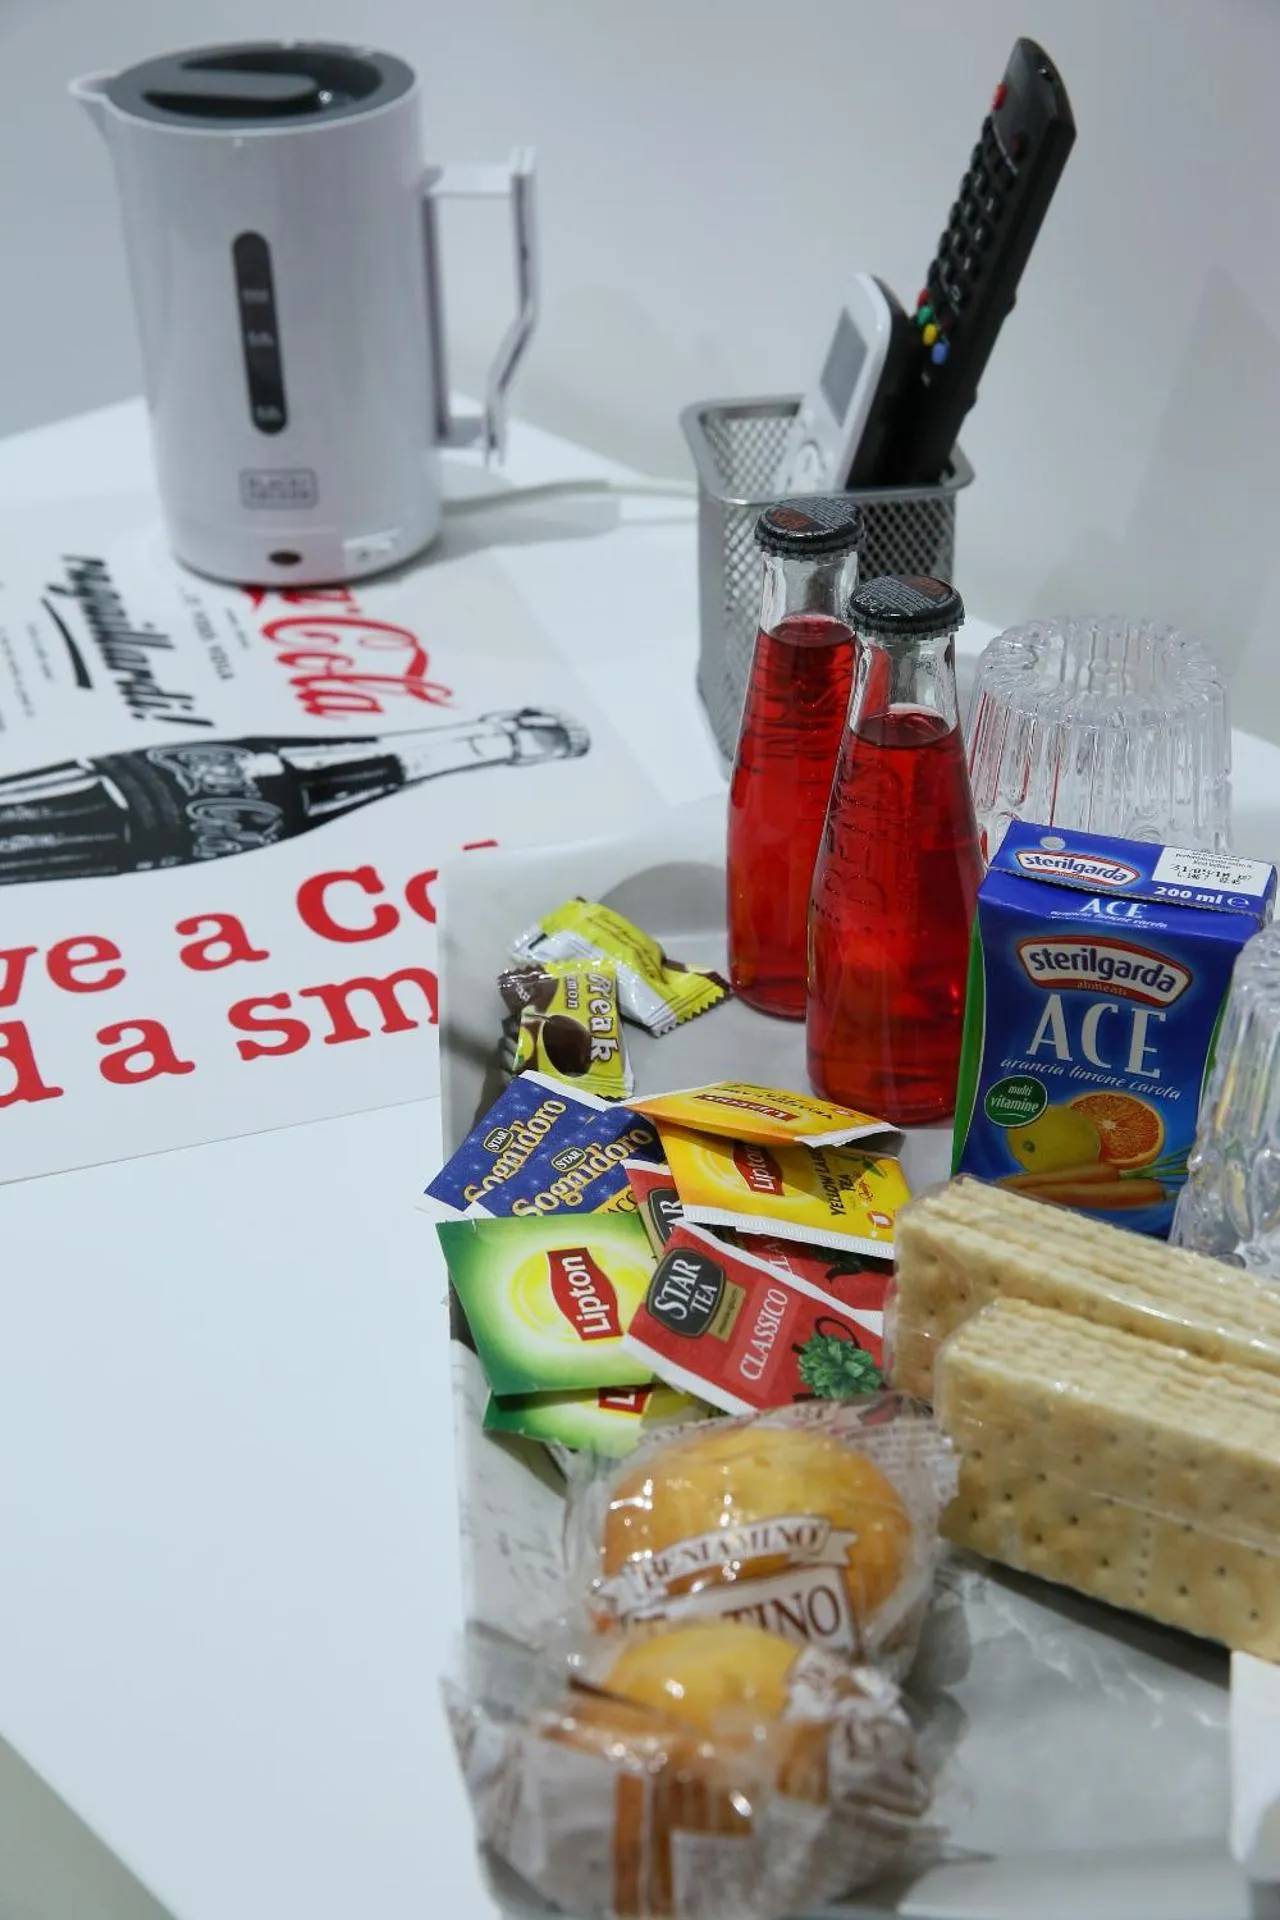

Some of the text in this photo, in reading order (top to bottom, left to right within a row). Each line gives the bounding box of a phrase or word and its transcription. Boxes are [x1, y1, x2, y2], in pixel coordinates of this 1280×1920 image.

[1023, 853, 1128, 883] sterilgarda
[1080, 898, 1148, 919] ACE
[1153, 886, 1223, 905] 200 ml
[175, 913, 270, 971] a
[1028, 947, 1177, 993] sterilgarda
[97, 1019, 196, 1085] a
[1025, 993, 1167, 1080] ACE
[1069, 1064, 1126, 1088] limone
[990, 1095, 1041, 1113] vitamine
[486, 1131, 508, 1151] STAR
[556, 1149, 581, 1170] STAR
[560, 1254, 613, 1334] Lipton
[654, 1258, 702, 1321] STAR
[689, 1283, 719, 1316] TEA
[738, 1288, 789, 1382] CLASSICO
